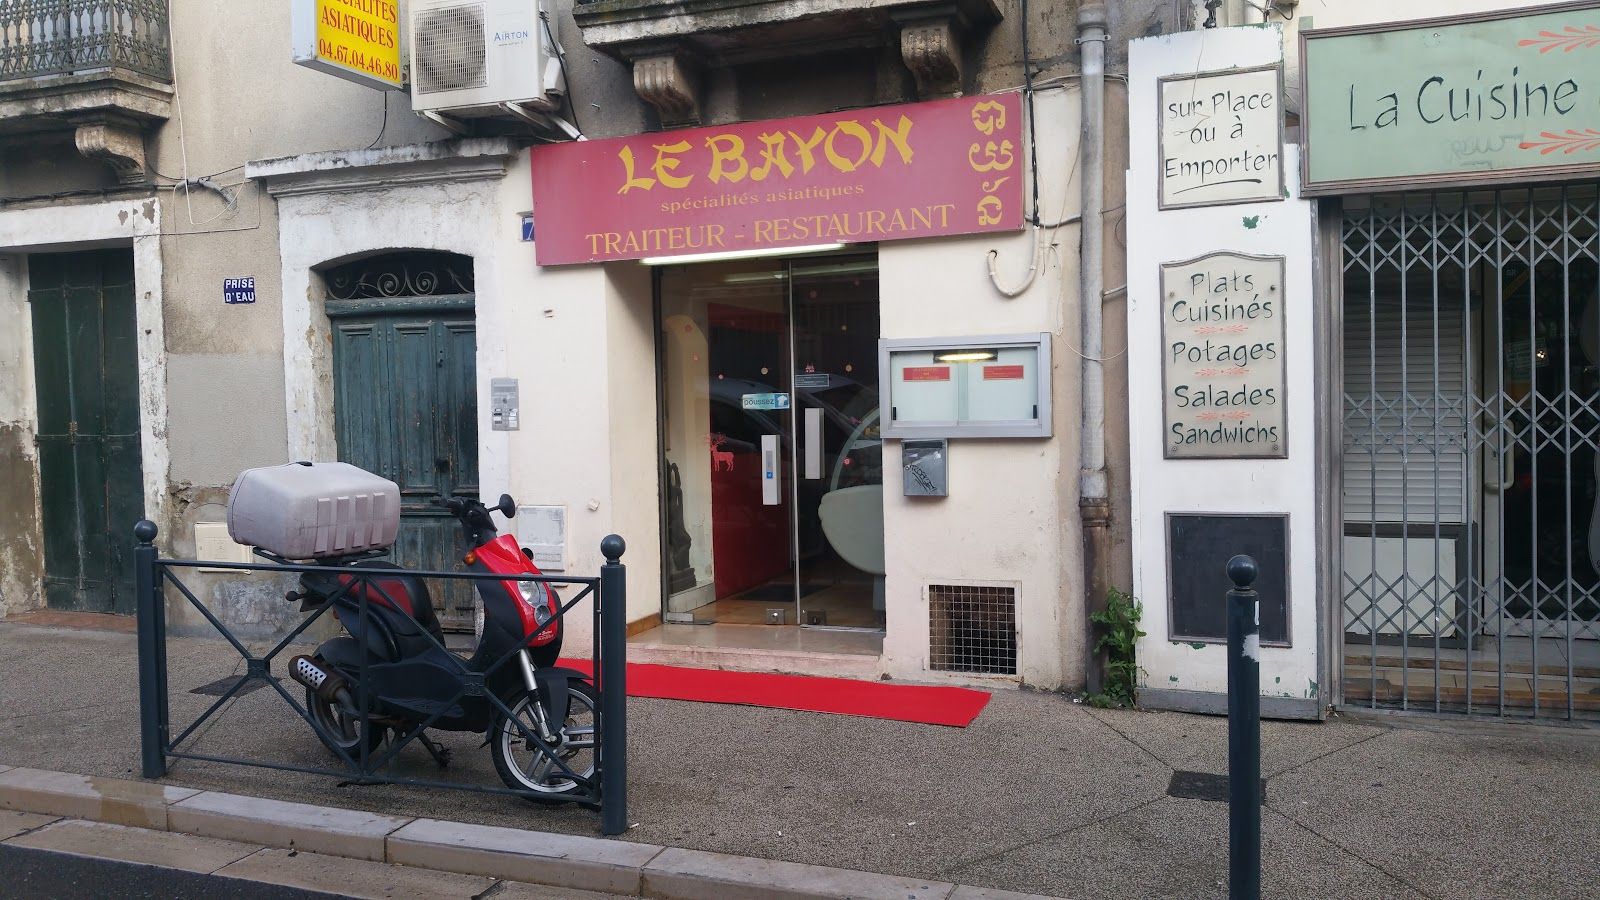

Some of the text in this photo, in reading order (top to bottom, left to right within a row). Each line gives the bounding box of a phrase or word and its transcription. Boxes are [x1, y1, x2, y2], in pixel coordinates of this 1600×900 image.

[321, 5, 394, 49] ASIATIQUES
[494, 30, 528, 41] AIRTON
[319, 38, 398, 81] 04.67.04.46.80
[1211, 90, 1273, 115] Place
[1350, 66, 1578, 131] La Cuisine
[1190, 115, 1243, 144] ou à
[617, 113, 915, 195] LE BAYON
[1165, 150, 1278, 183] Emporter
[661, 184, 865, 214] spécialités asiatiques
[585, 224, 726, 255] TRAITEUR
[754, 204, 956, 243] RESTAURANT
[225, 278, 254, 289] PRISE
[1190, 270, 1254, 295] Plats
[225, 292, 254, 302] D'EAU
[1172, 294, 1273, 322] Cuisinés
[1172, 340, 1276, 367] Potages
[744, 399, 775, 407] poussez
[1174, 384, 1276, 407] Salades
[1171, 420, 1278, 444] Sandwichs
